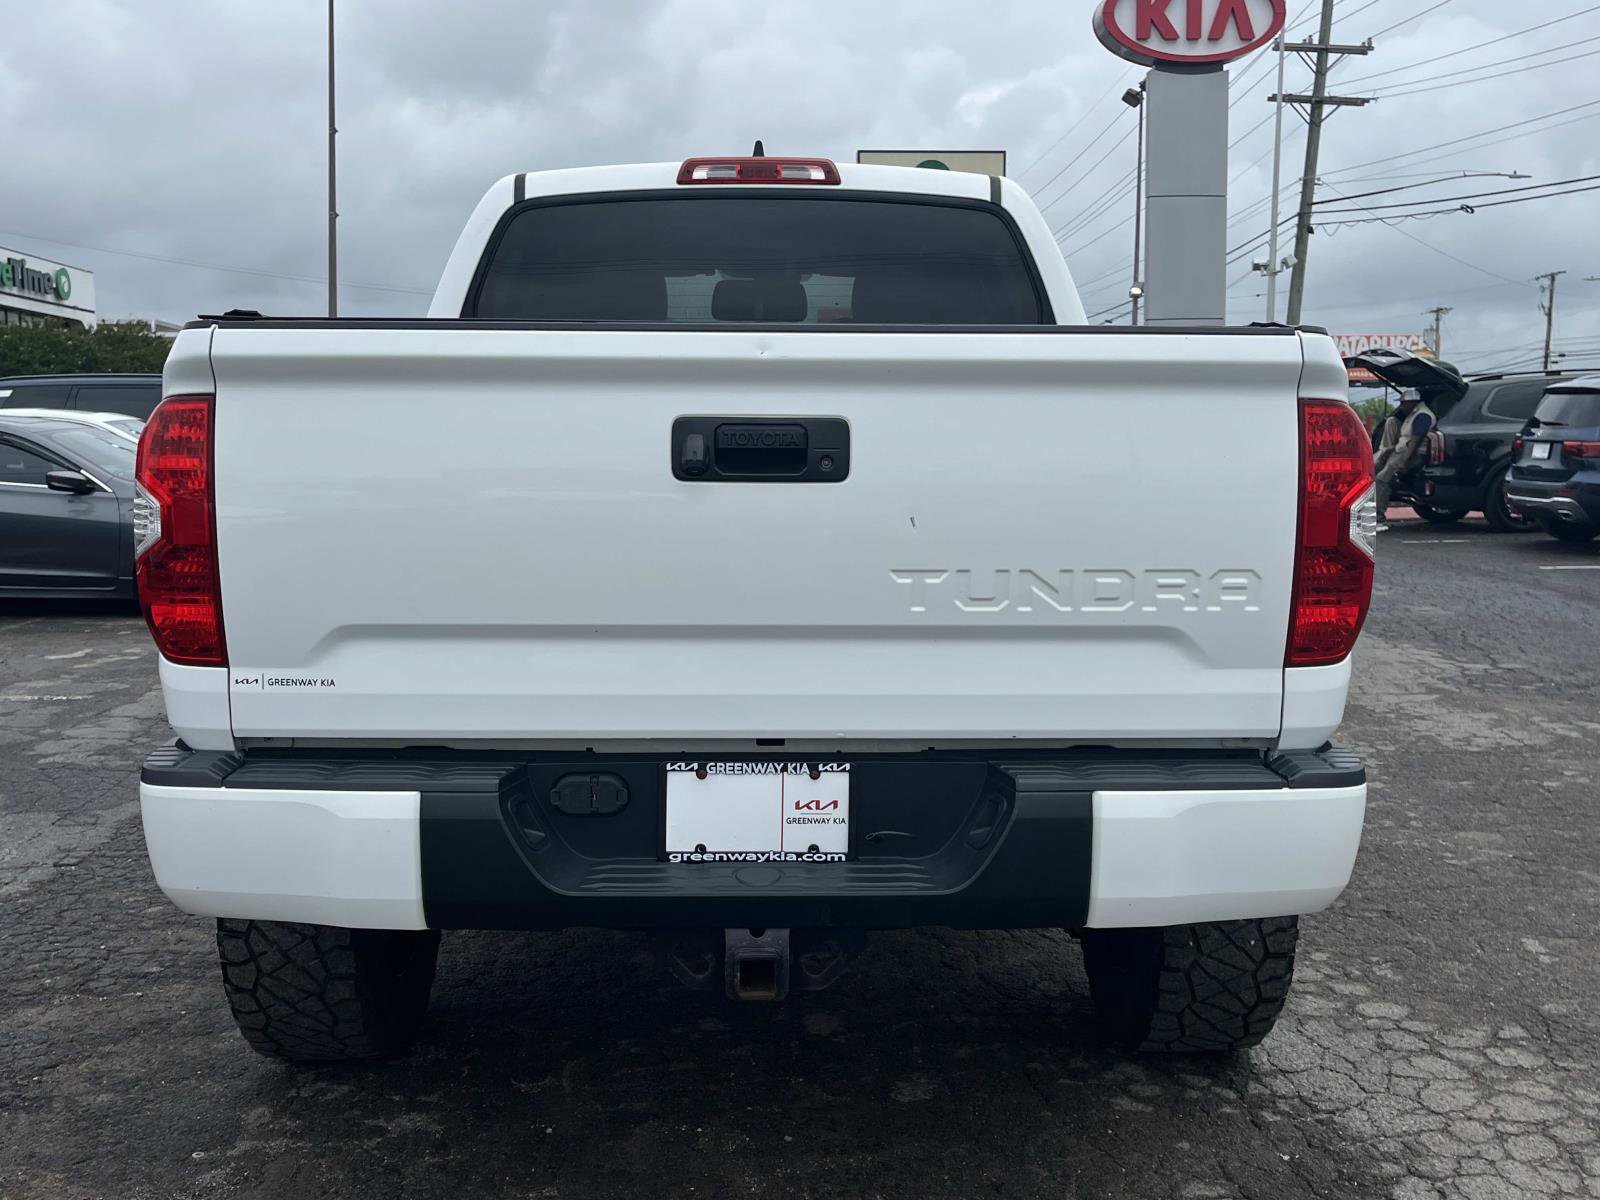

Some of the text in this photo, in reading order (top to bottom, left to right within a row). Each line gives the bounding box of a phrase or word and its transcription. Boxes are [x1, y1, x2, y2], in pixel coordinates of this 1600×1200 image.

[1136, 0, 1255, 41] KIA
[0, 257, 53, 294] eTime
[723, 431, 800, 448] TOYOTA
[889, 568, 1262, 612] TUNDRA
[267, 678, 318, 687] GREENWAY
[320, 678, 336, 687] KIA
[666, 762, 850, 775] KIA GREENWAY KIA KIA
[794, 800, 839, 811] KIA
[786, 817, 847, 825] GREENWAY KIA
[668, 850, 847, 863] greenwaykia.com
